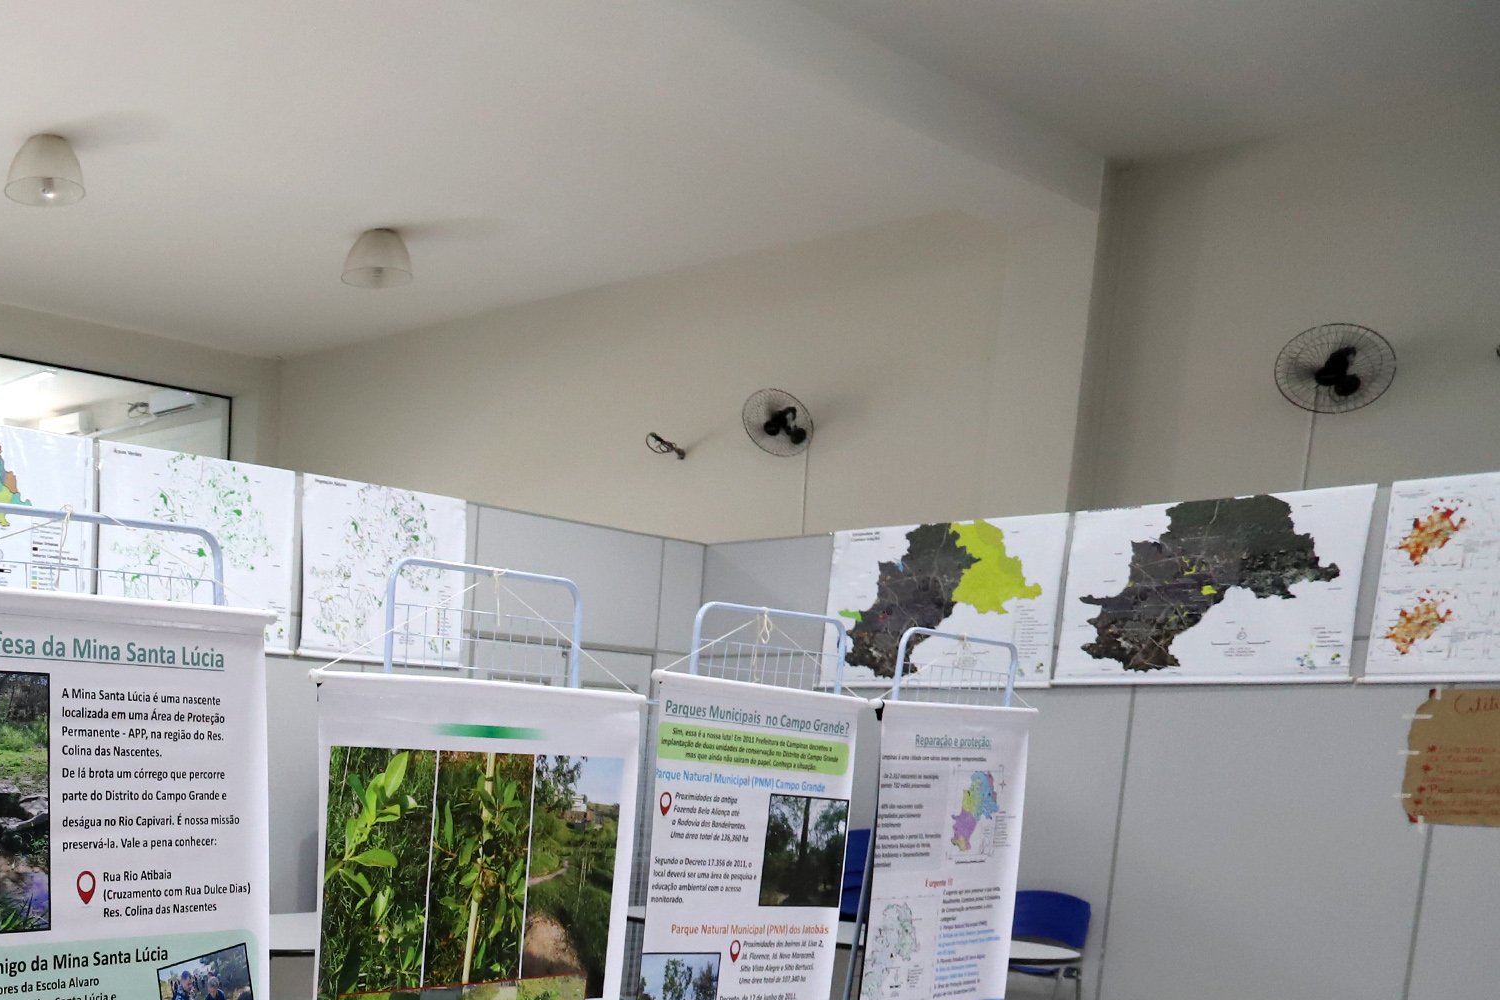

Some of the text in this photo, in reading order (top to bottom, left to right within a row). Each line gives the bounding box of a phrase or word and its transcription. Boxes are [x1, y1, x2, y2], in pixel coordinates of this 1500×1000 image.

[42, 635, 65, 657] da
[73, 638, 120, 661] Mina
[127, 642, 175, 664] Santa
[182, 646, 224, 668] Lúcia
[62, 688, 69, 698] A
[72, 689, 96, 699] Mina
[99, 690, 125, 701] Santa
[128, 691, 150, 702] Lúcia
[153, 692, 158, 702] é
[183, 697, 220, 705] nascente
[665, 700, 850, 735] Parques Municipais no Campo Grande?
[915, 734, 953, 748] Reparação
[683, 770, 712, 782] Natural
[714, 773, 750, 787] Municipal
[752, 776, 774, 789] (PNM)
[776, 779, 800, 791] Campo
[802, 781, 825, 792] Grande
[103, 870, 171, 882] Rua Rio Atibaia
[104, 882, 250, 902] (Cruzamento com Rua Dulce Dias)
[104, 903, 216, 917] Res. Colina das Nascentes
[672, 924, 828, 936] Parque Natural Municipal (PNM) dos Jatobás
[31, 955, 47, 971] da
[54, 953, 88, 970] Mina
[93, 951, 130, 966] Santa
[136, 947, 168, 962] Lúcia
